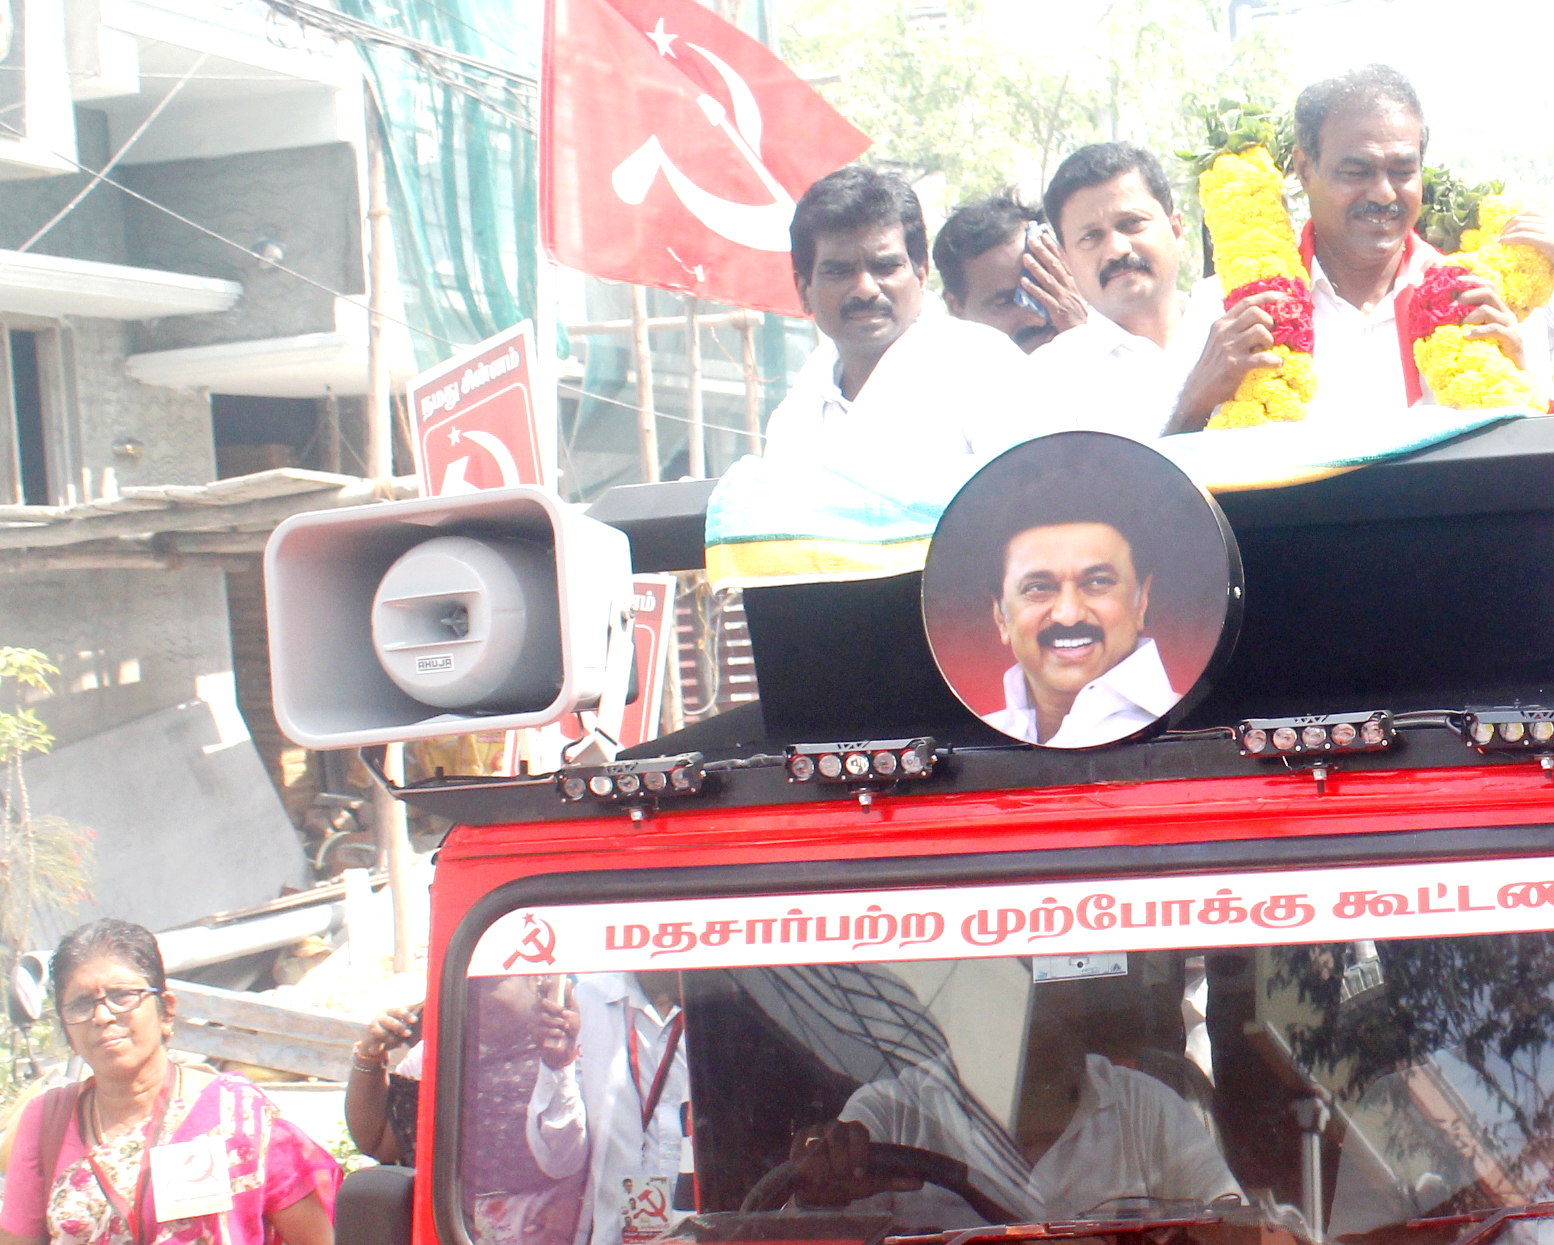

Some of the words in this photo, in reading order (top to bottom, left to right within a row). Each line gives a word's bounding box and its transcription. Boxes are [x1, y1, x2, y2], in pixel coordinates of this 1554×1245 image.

[417, 658, 452, 669] AHUJA
[605, 904, 945, 959] மதசார்பற்ற
[960, 888, 1316, 947] முற்போக்கு
